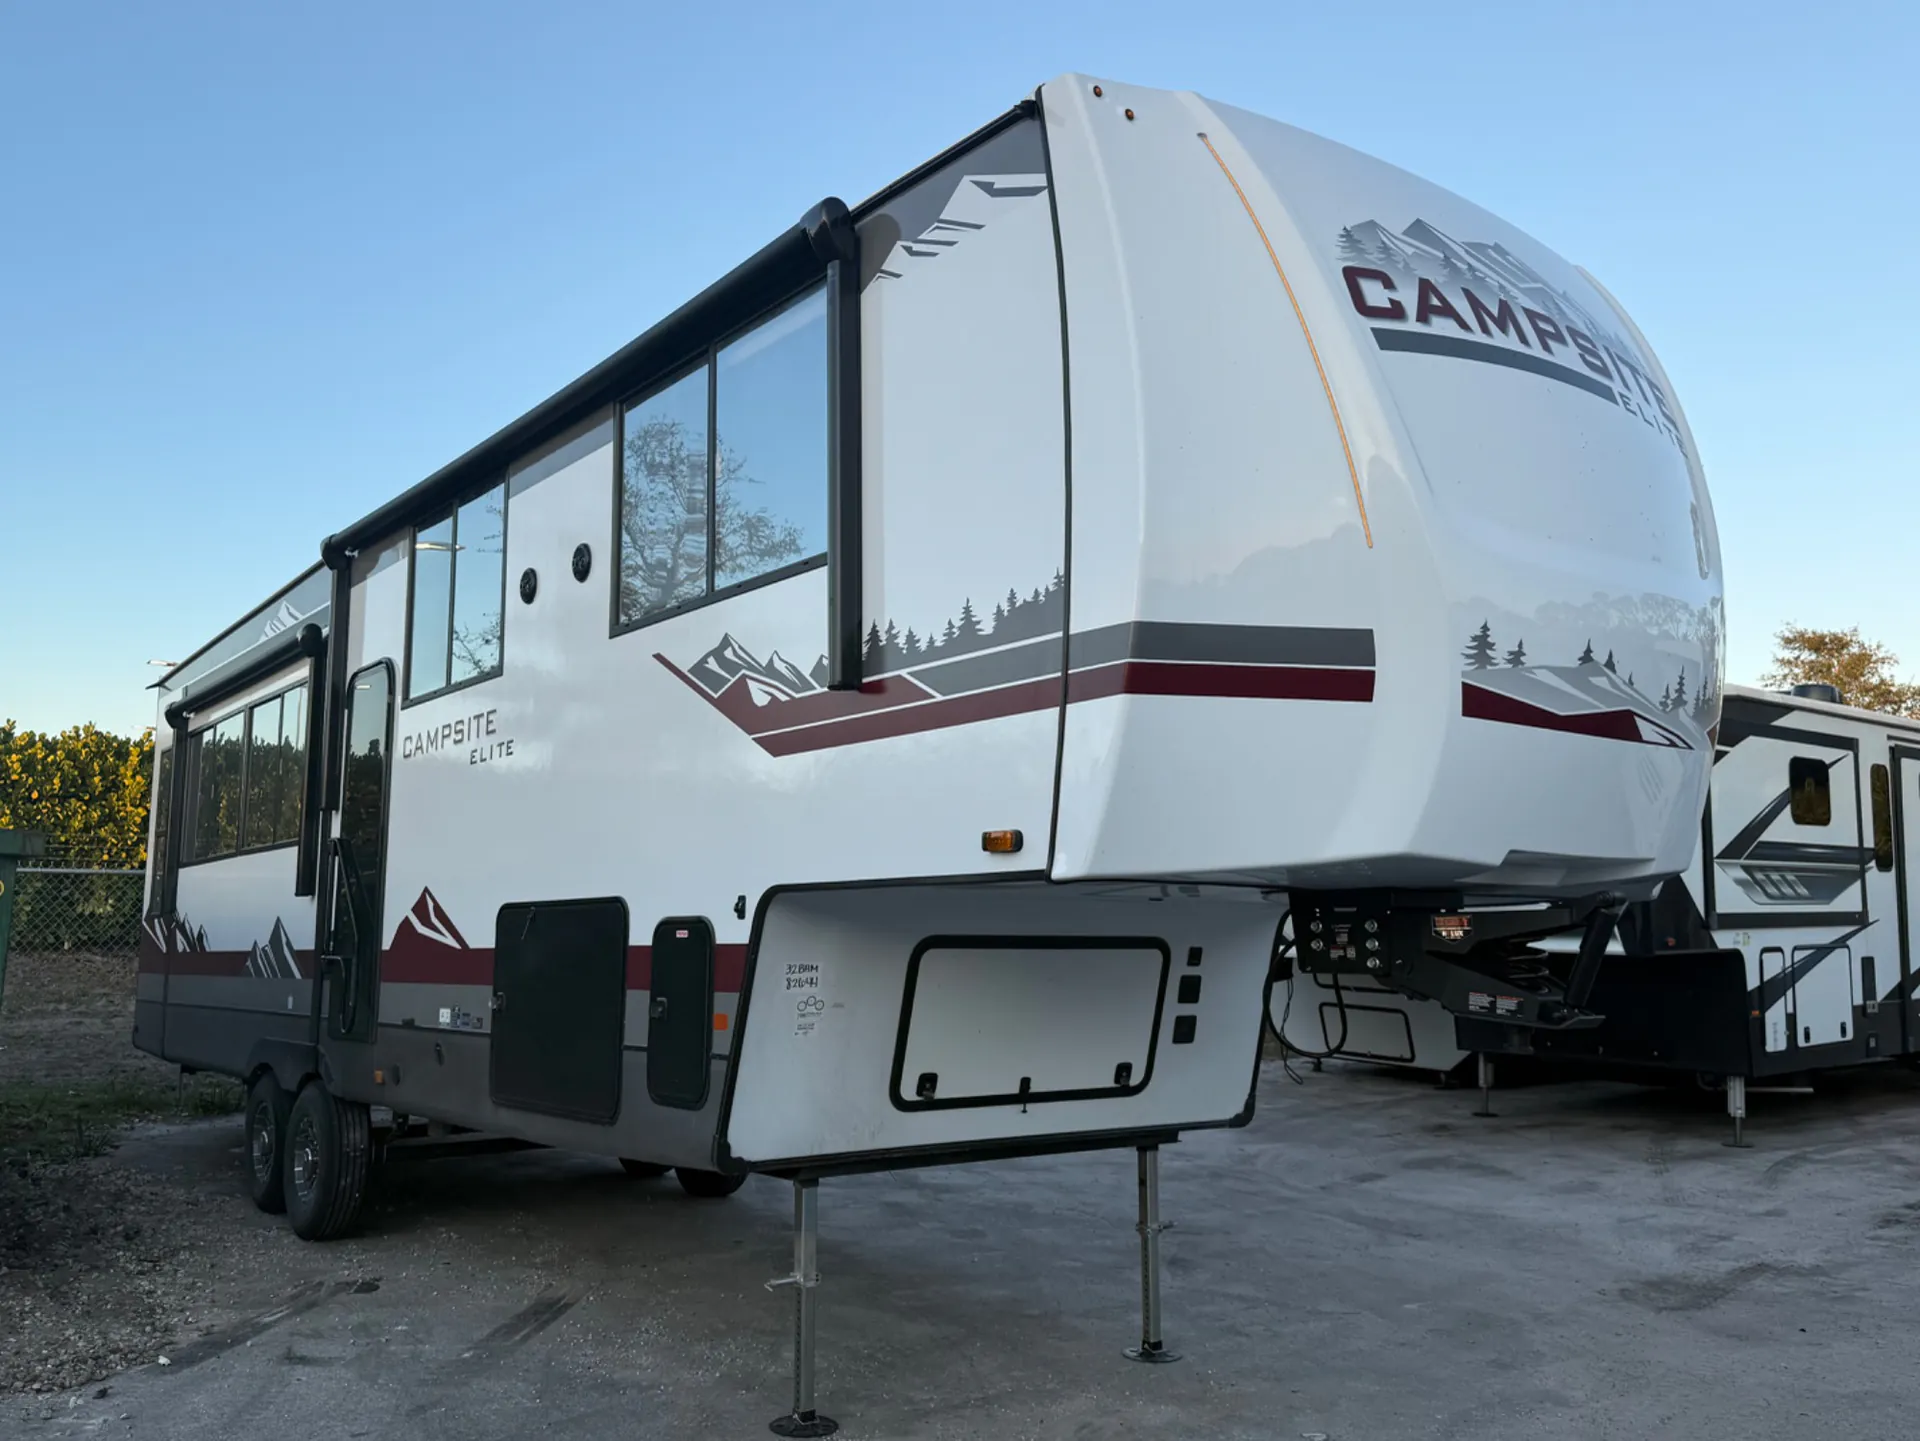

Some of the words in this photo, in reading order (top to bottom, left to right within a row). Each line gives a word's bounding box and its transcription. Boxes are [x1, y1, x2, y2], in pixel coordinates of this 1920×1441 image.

[1342, 265, 1681, 436] CAMPSITE
[1618, 391, 1688, 459] ELITE
[403, 709, 497, 759] CAMPSITE
[469, 739, 515, 765] ELITE
